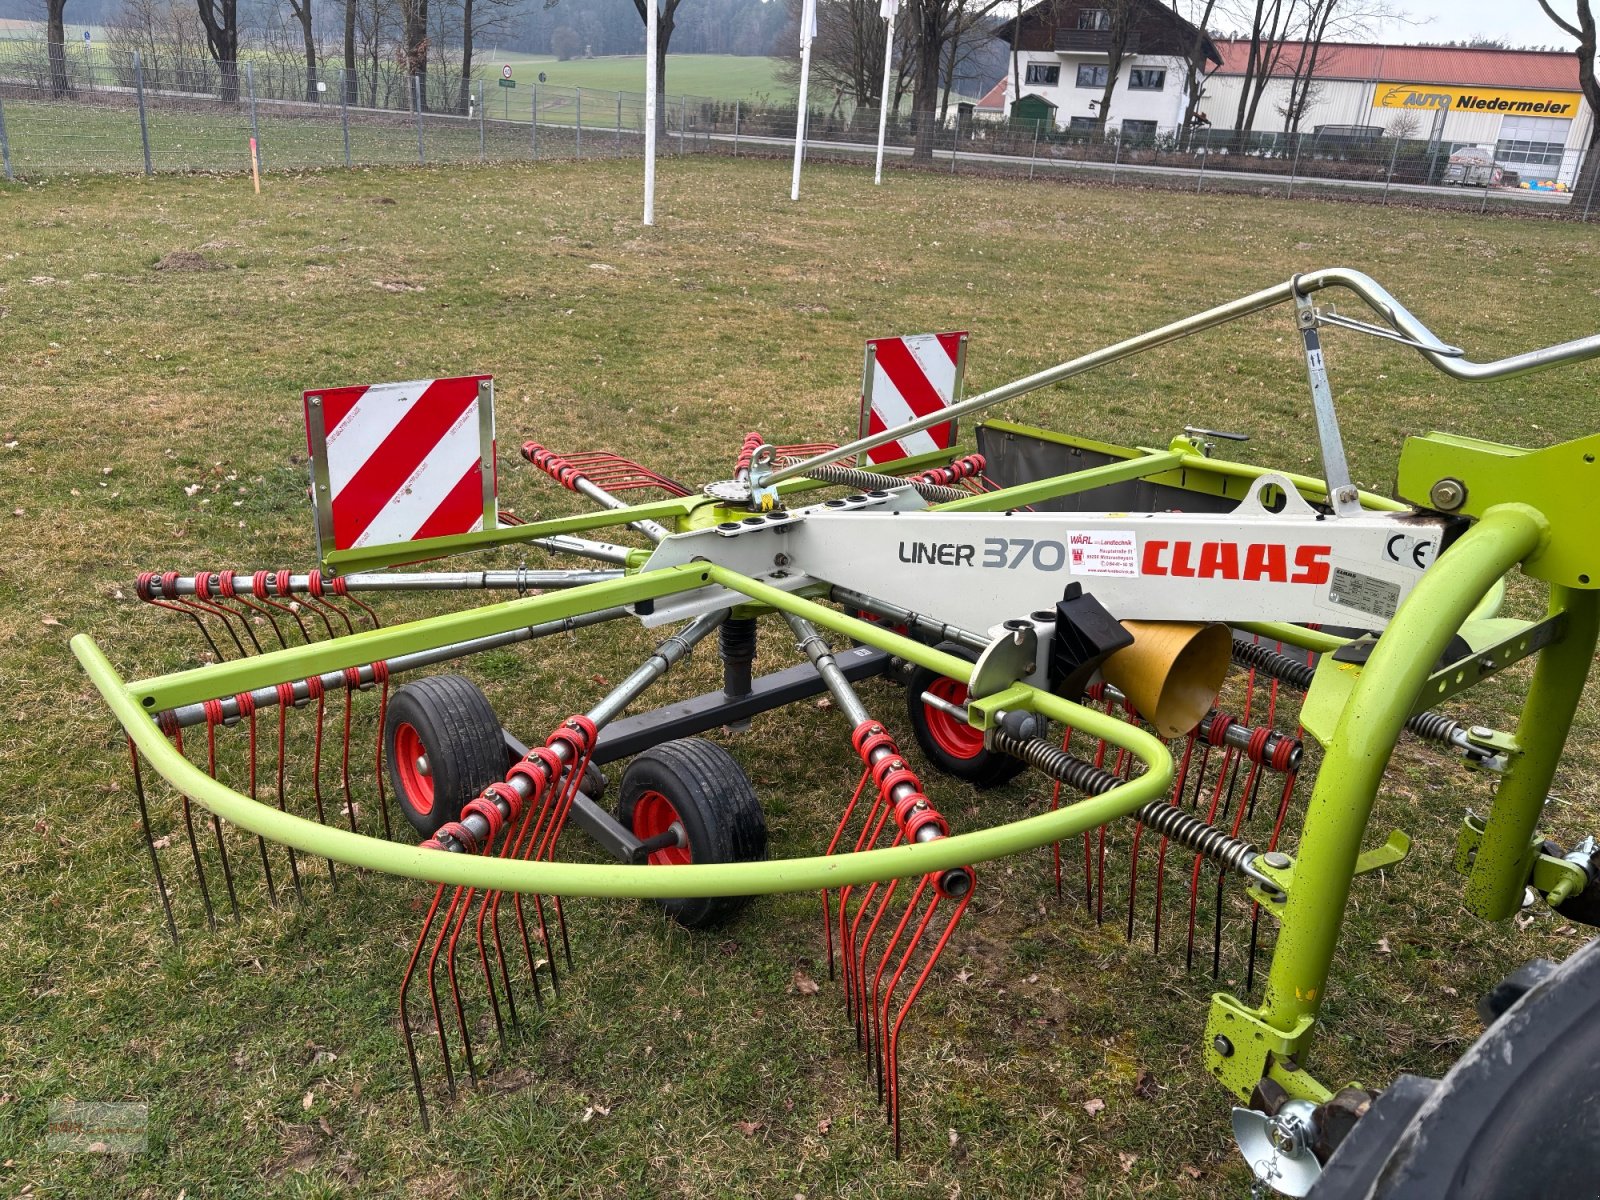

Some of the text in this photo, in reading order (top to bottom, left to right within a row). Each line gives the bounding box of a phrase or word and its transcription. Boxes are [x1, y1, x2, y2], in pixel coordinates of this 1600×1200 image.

[1403, 92, 1571, 114] AUTO Niedermeier
[1070, 533, 1093, 545] WÄRL
[898, 541, 976, 567] LINER
[982, 538, 1065, 572] 370
[1141, 540, 1332, 585] CLAAS
